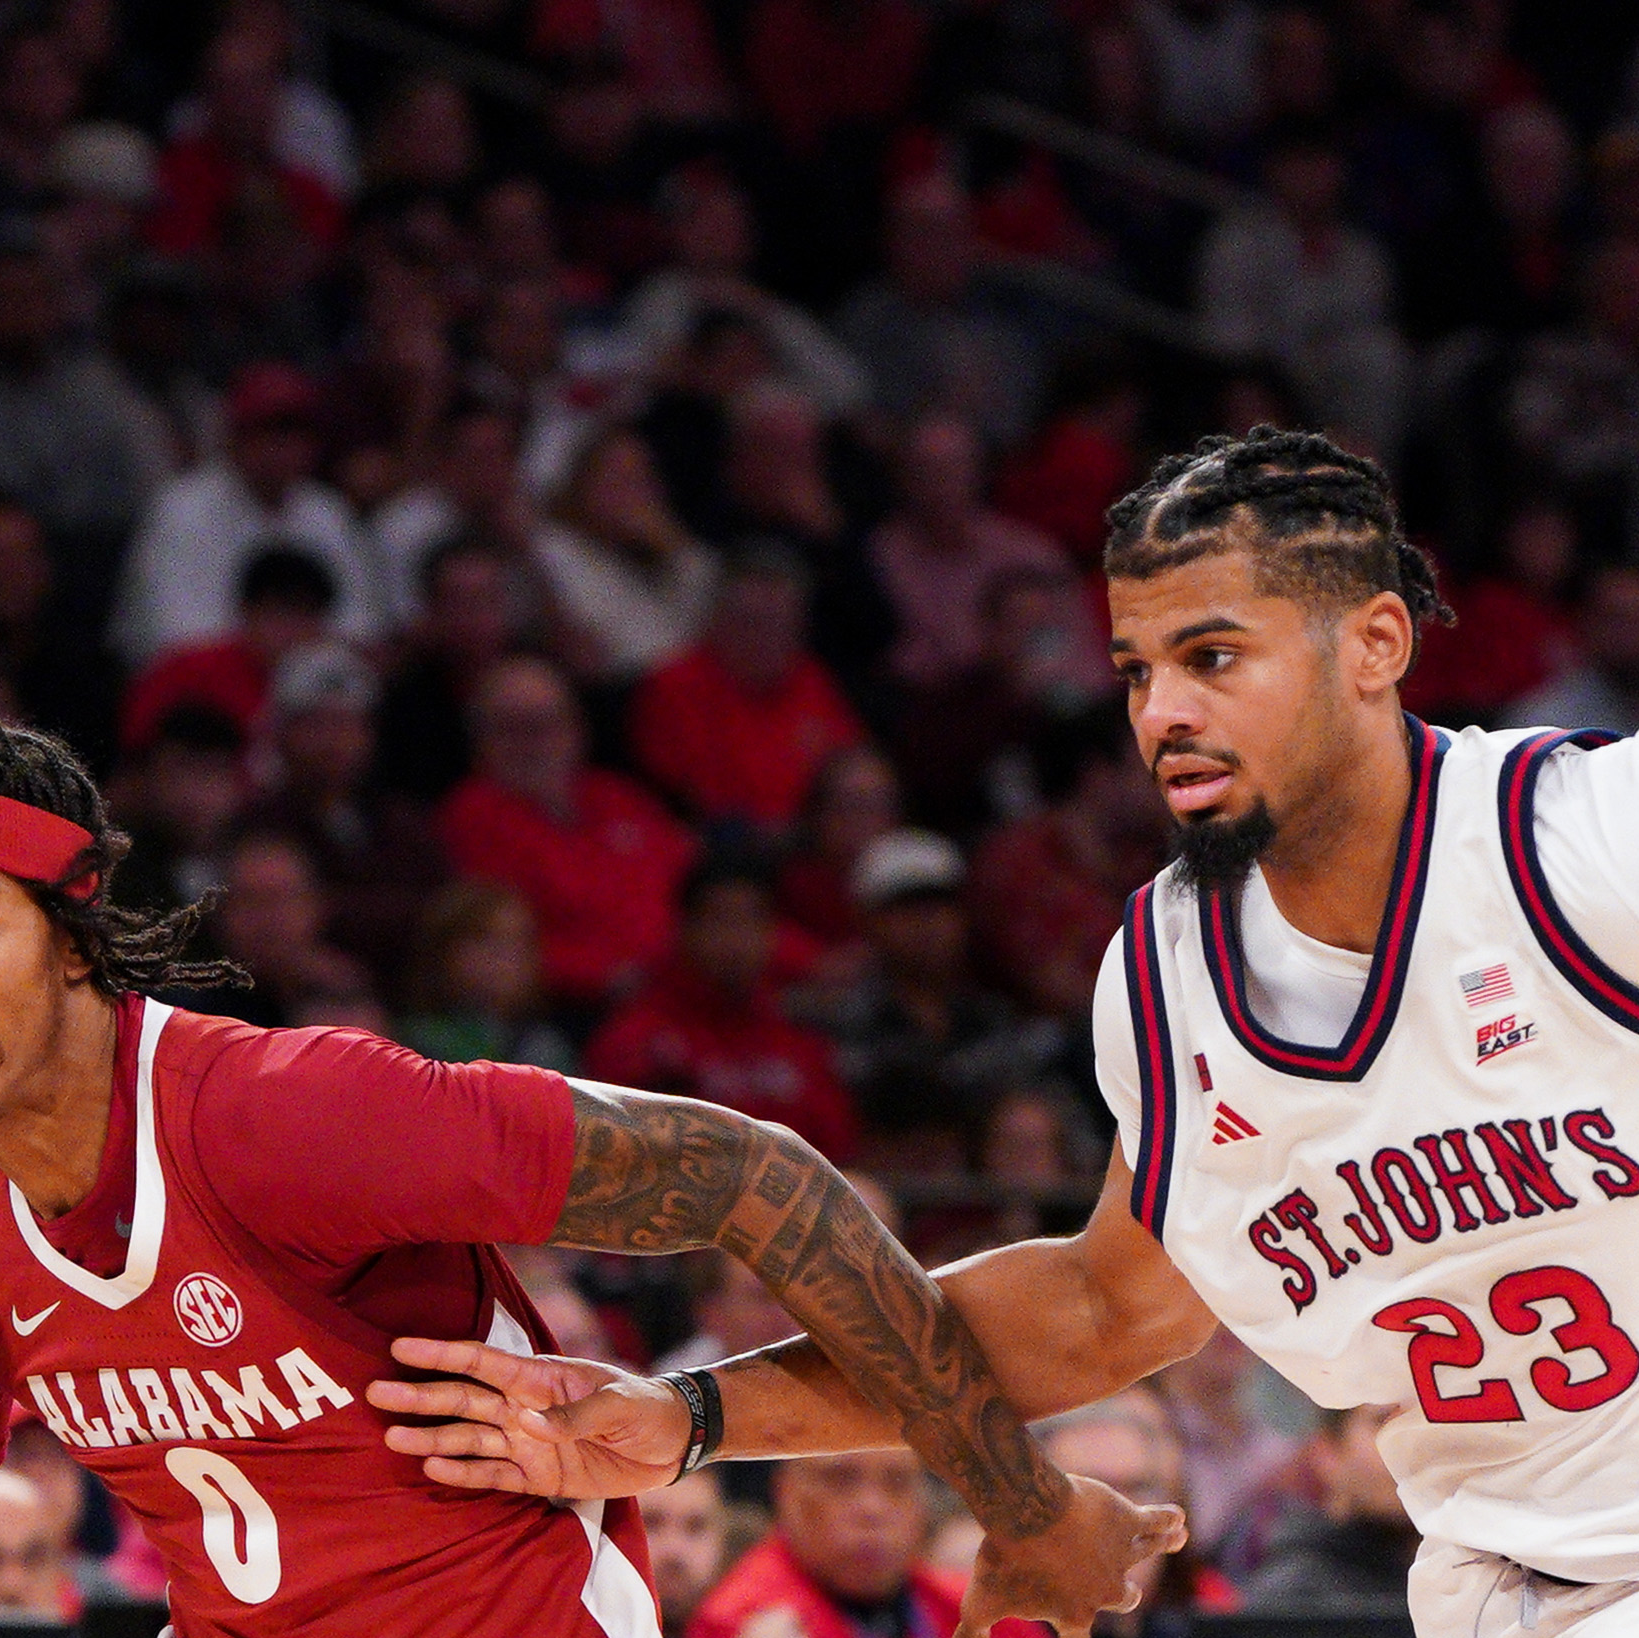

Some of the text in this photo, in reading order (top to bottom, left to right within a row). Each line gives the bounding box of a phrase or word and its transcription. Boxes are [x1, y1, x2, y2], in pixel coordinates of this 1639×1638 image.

[1476, 1013, 1516, 1044] BIG
[1476, 1021, 1536, 1058] EAST
[179, 1279, 237, 1342] SEC
[25, 1347, 355, 1447] ALABAMA
[164, 1446, 282, 1605] 0
